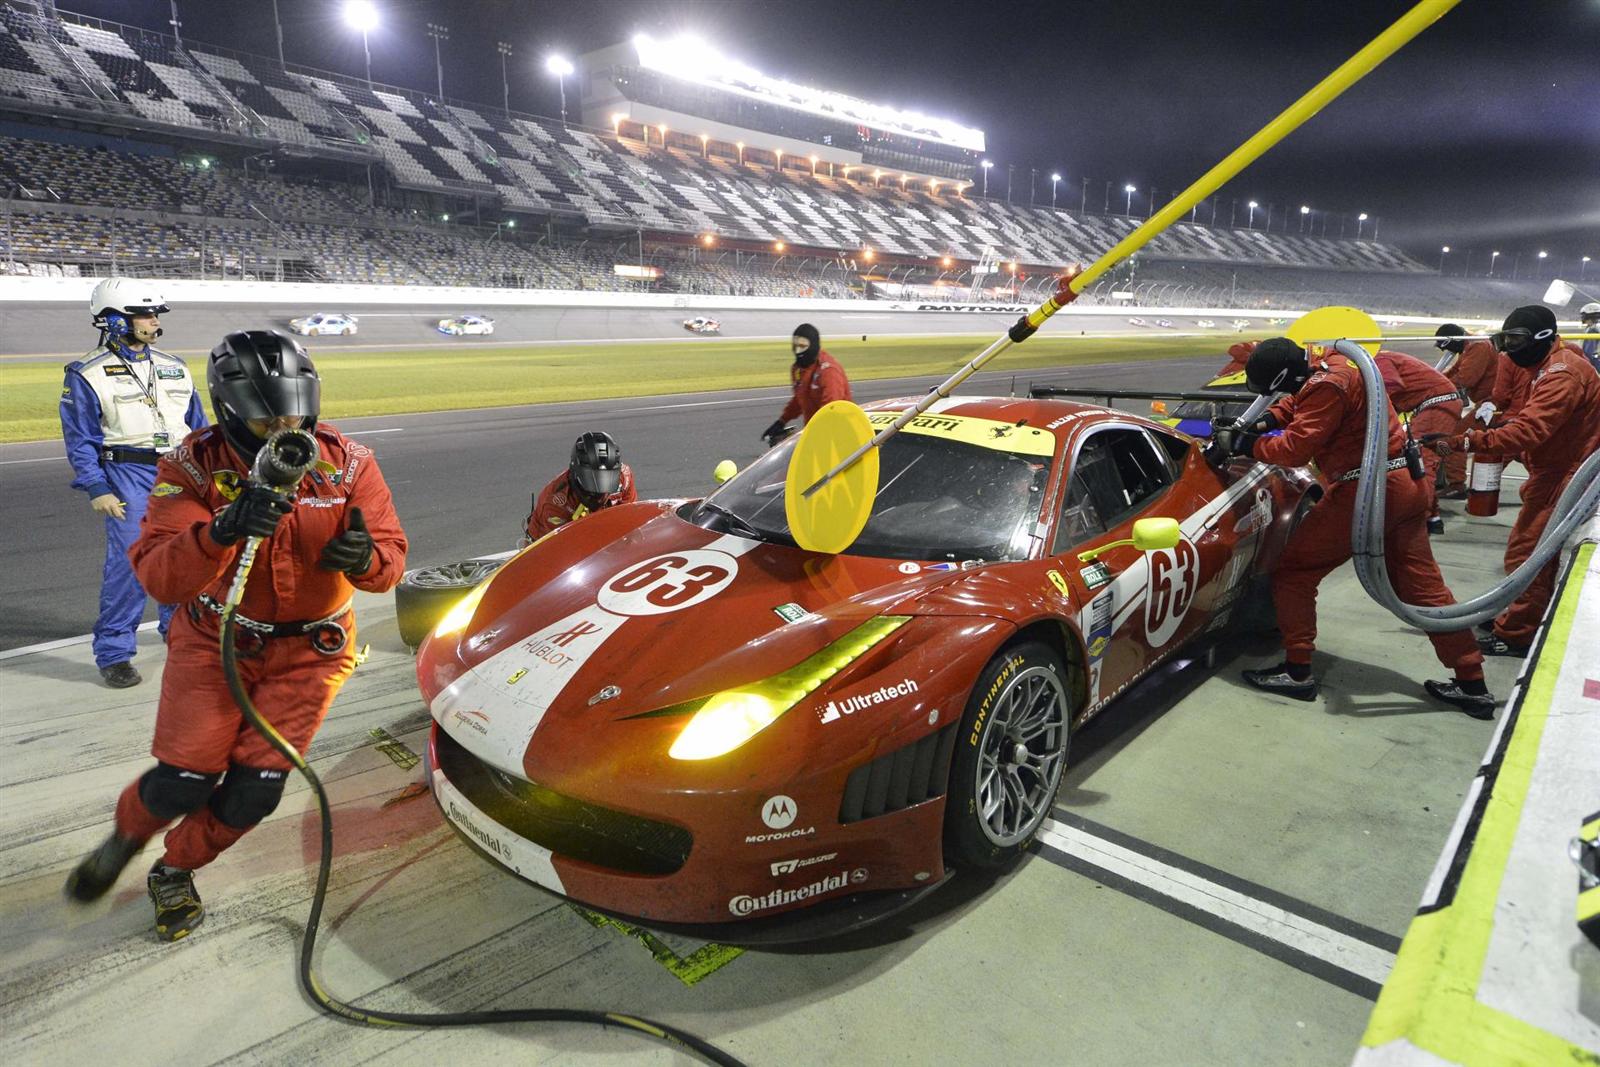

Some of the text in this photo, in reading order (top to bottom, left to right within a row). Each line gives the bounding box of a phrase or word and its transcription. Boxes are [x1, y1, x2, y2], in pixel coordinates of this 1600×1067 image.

[917, 304, 1029, 312] DAYTONA
[608, 556, 729, 607] 63
[1147, 539, 1195, 633] 63
[521, 640, 574, 668] HUBLOT
[838, 678, 918, 715] Ultratech
[970, 655, 1025, 746] CONTINENTAL
[448, 801, 502, 856] Continental
[745, 826, 815, 843] MOTOROLA
[728, 871, 849, 916] Continental
